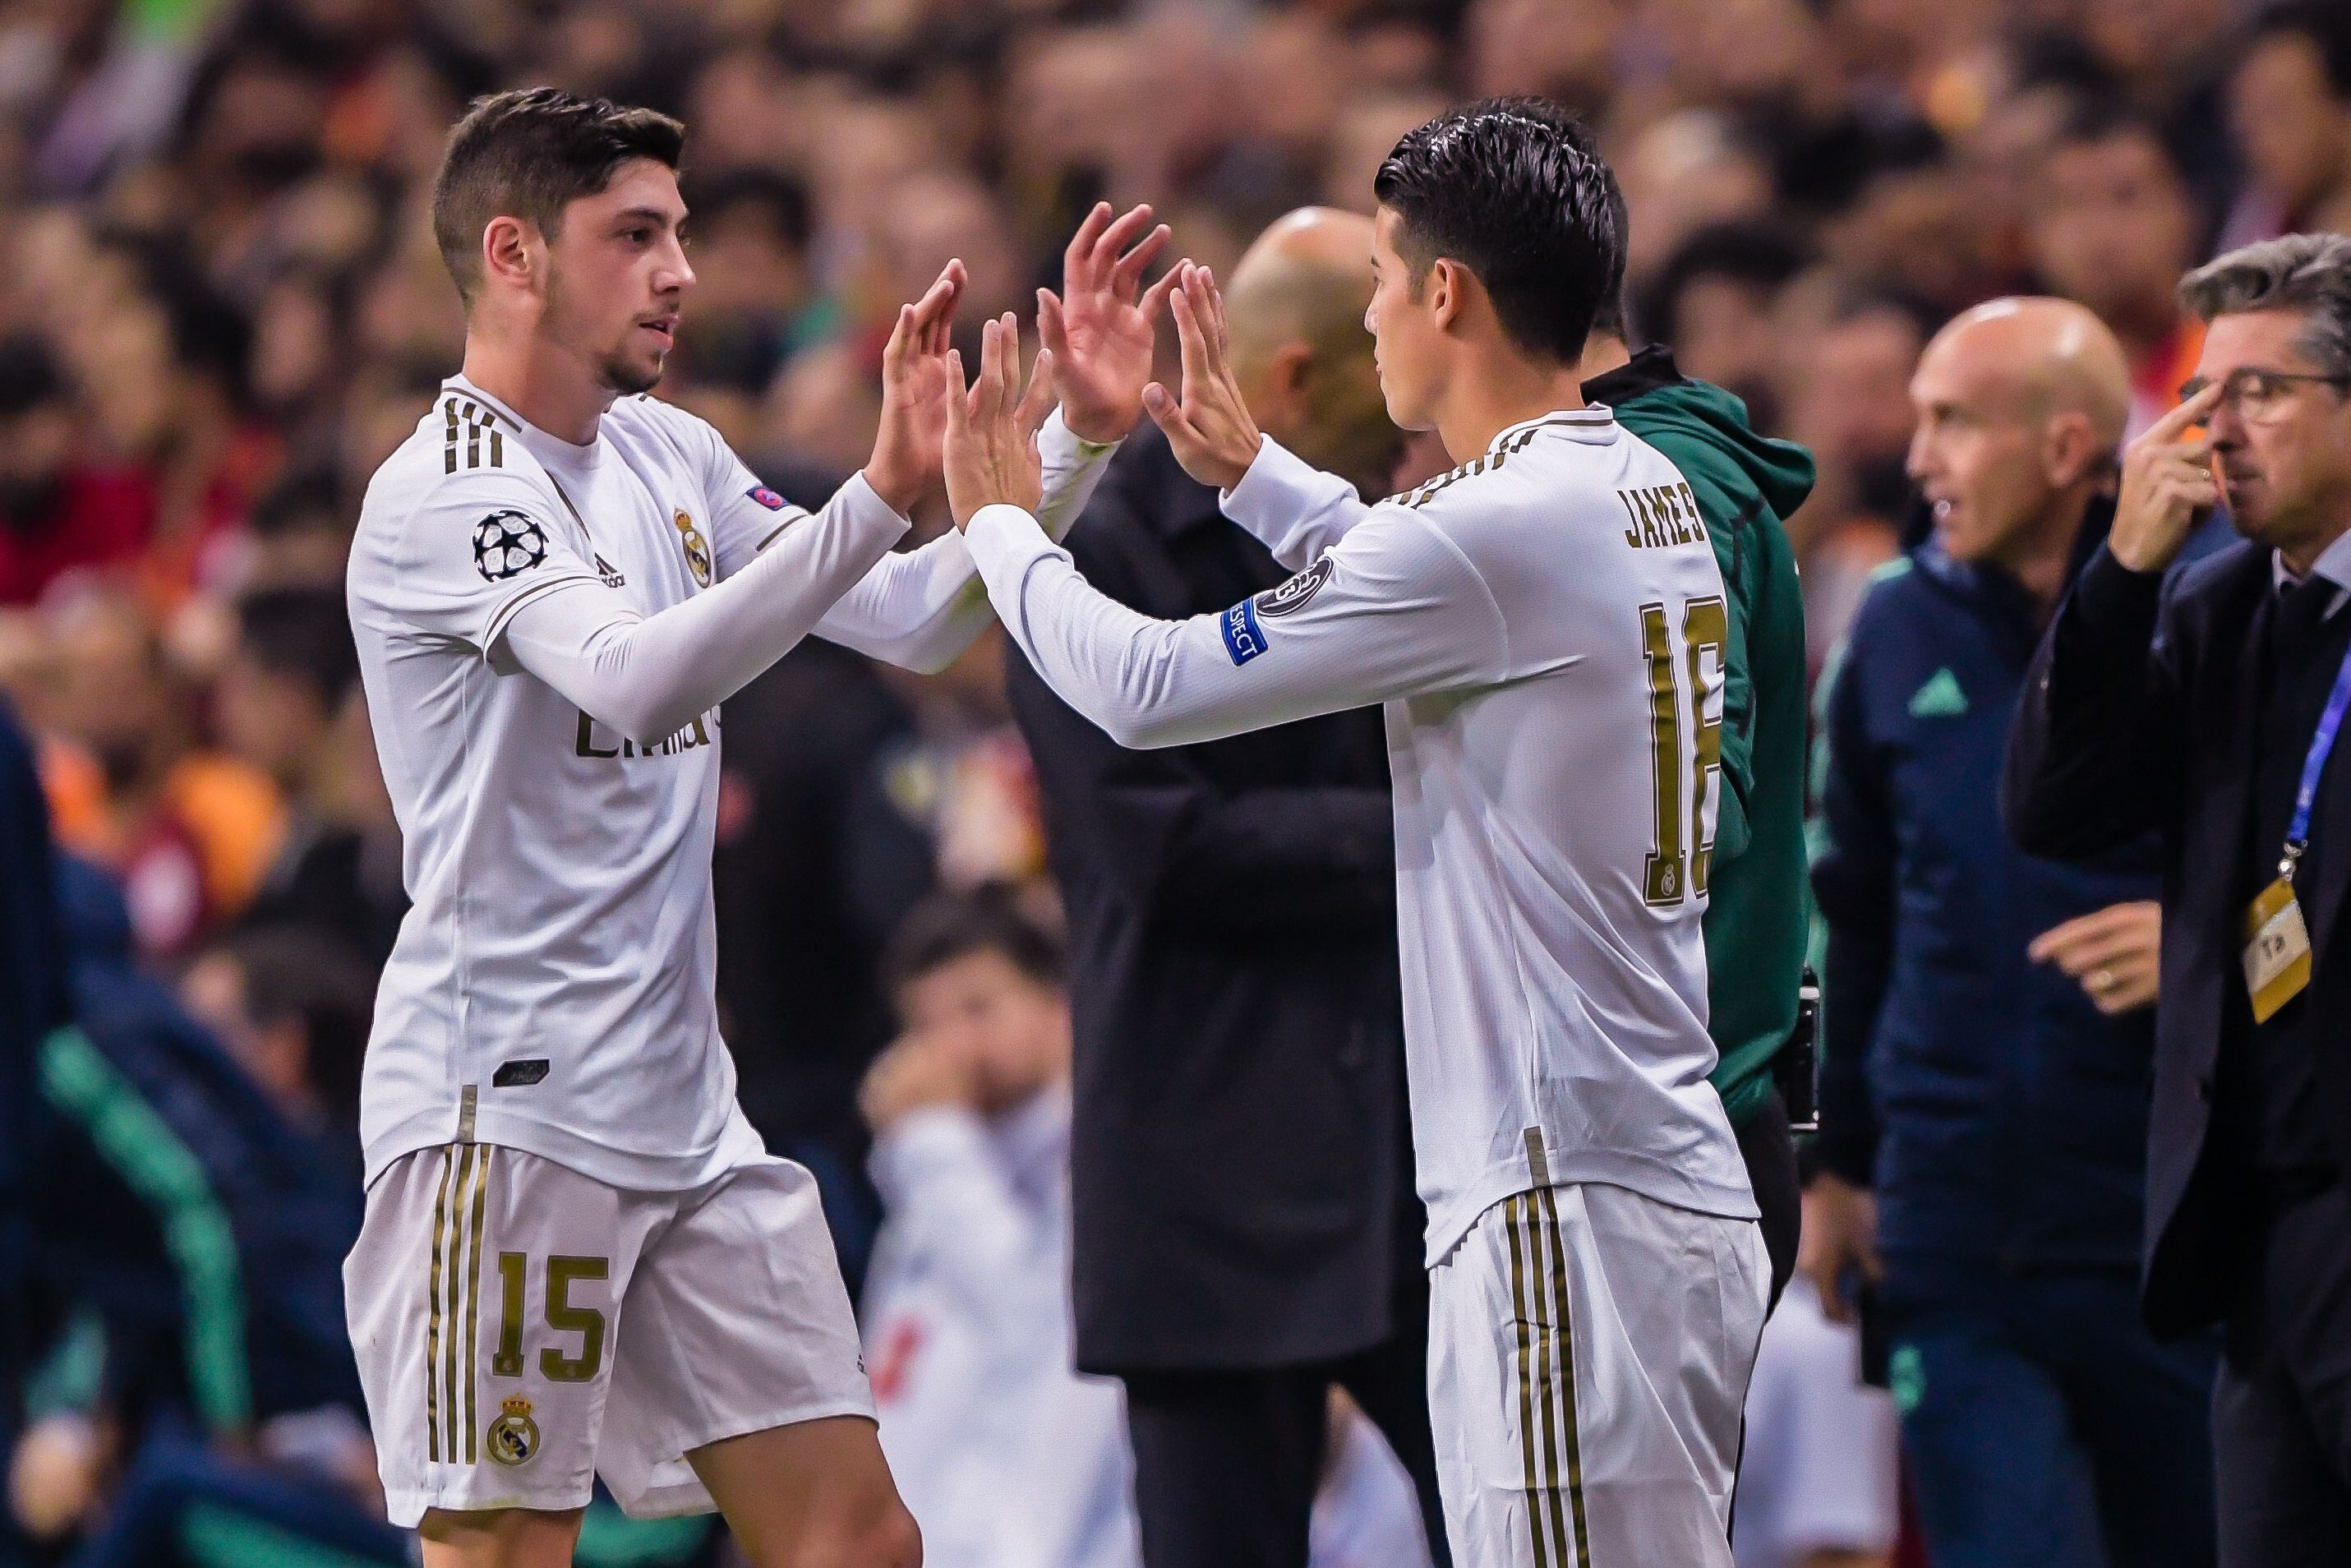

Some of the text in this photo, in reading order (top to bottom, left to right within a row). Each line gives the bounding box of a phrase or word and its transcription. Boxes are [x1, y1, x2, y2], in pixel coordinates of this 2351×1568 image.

[1617, 482, 1705, 548] JAMES
[1229, 604, 1258, 657] ESPECT
[493, 1252, 609, 1382] 15
